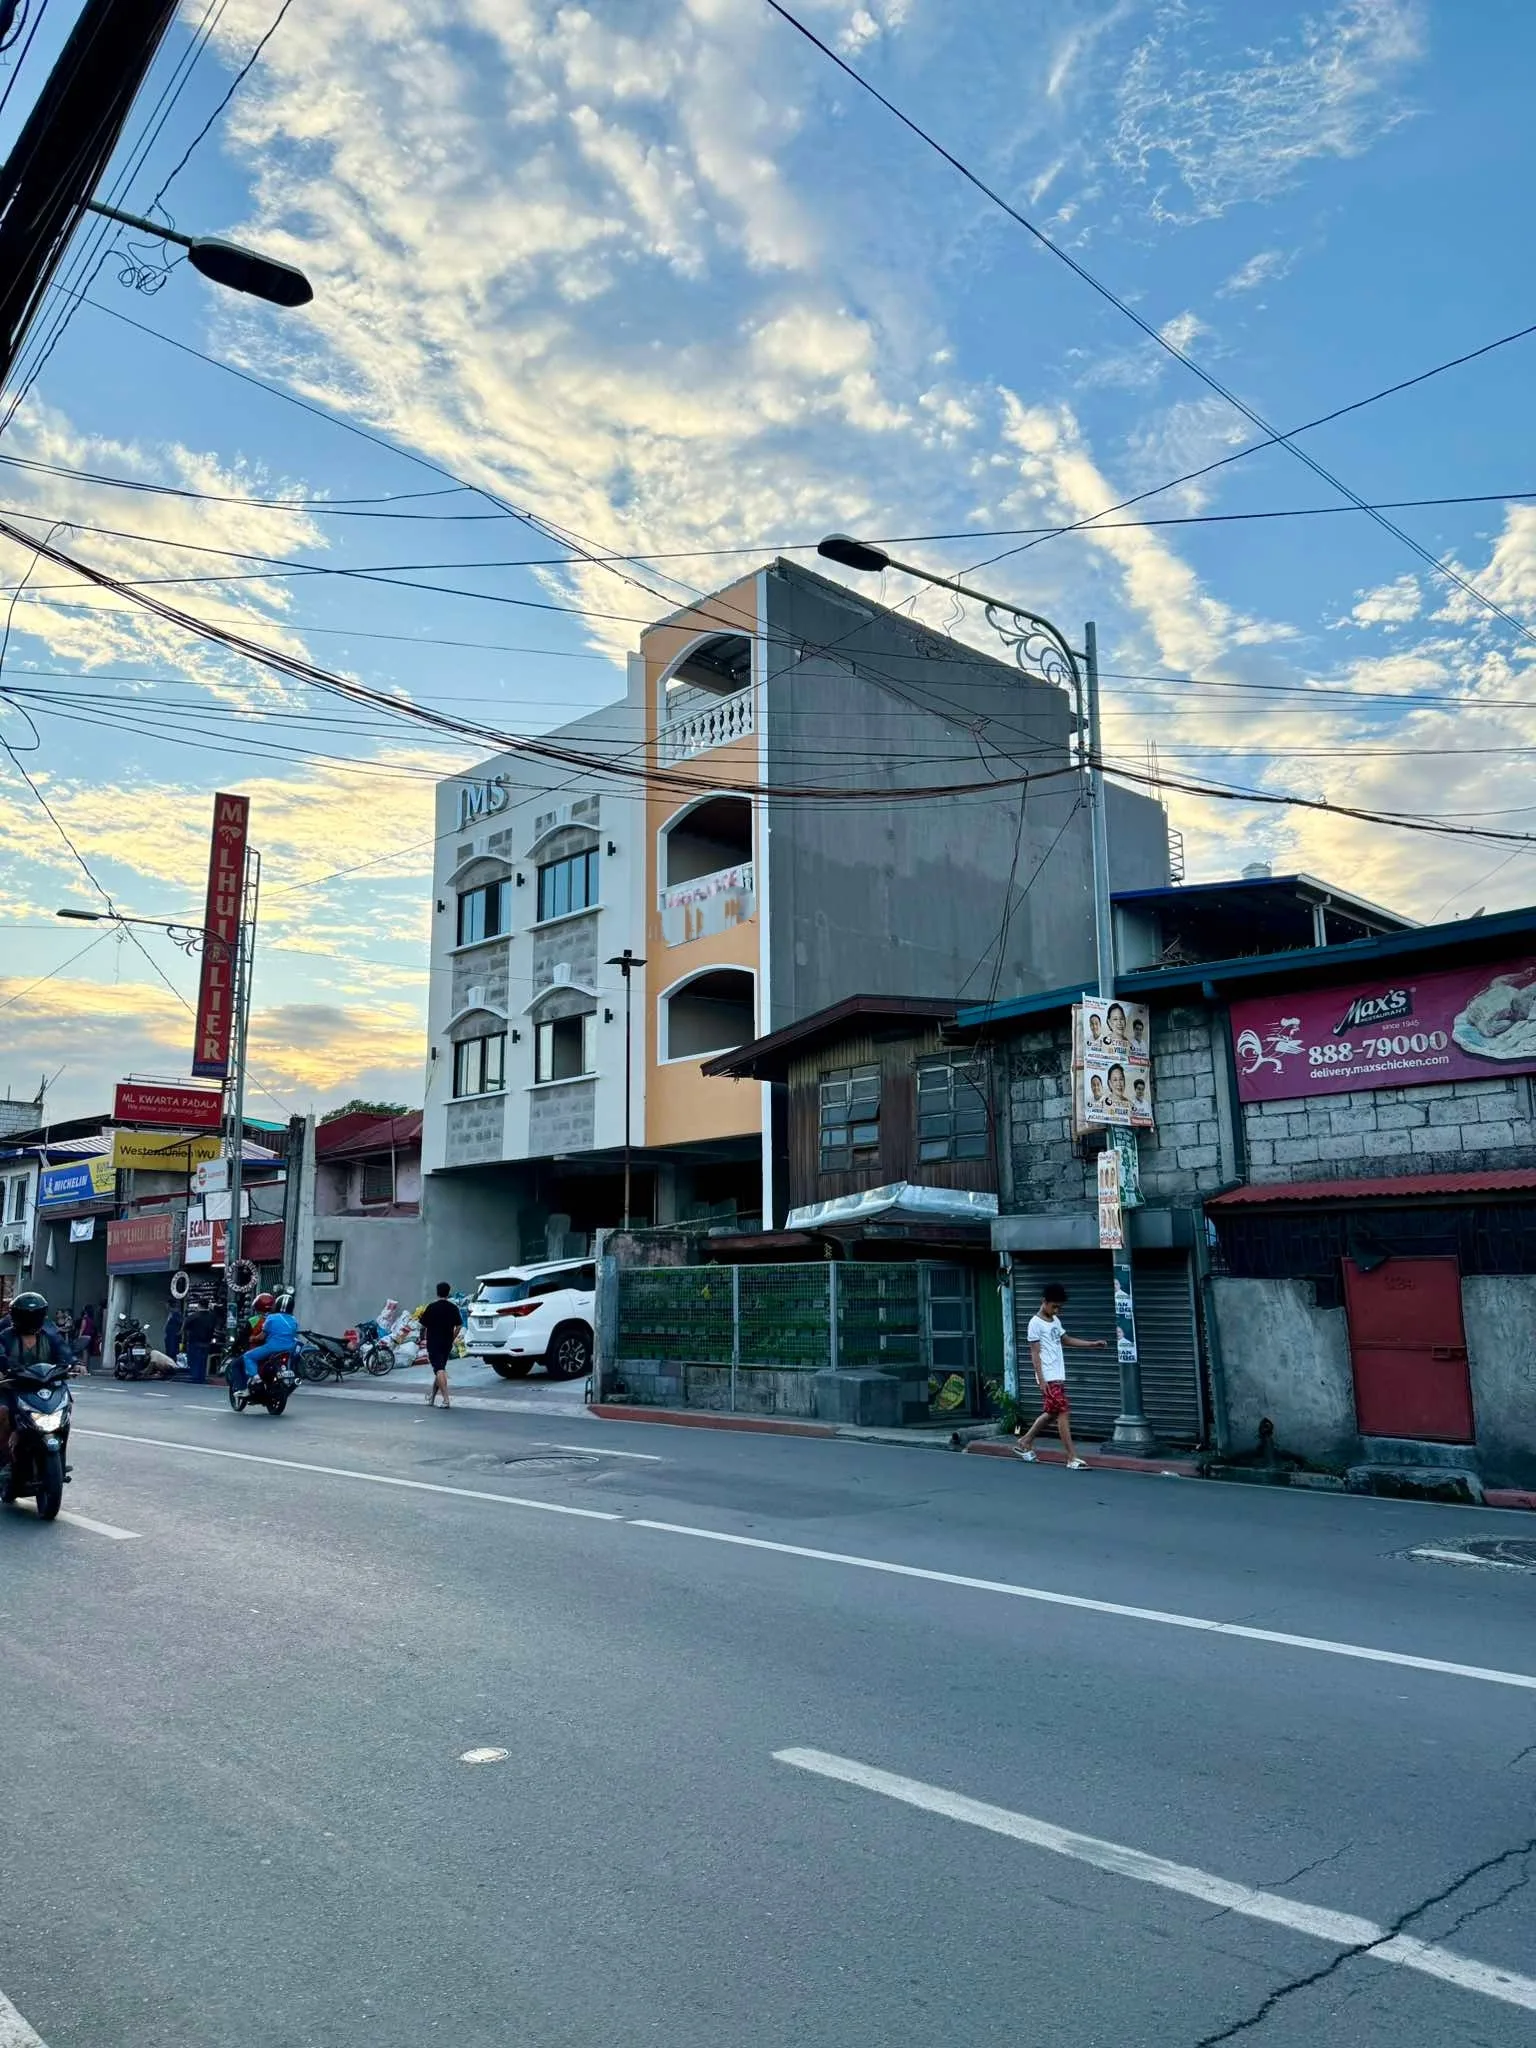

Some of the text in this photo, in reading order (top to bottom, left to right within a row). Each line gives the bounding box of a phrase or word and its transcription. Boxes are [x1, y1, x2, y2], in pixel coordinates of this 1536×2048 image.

[221, 801, 242, 823] M
[1332, 989, 1406, 1034] Max's
[1360, 1007, 1408, 1023] RESTAURANT
[1382, 1019, 1420, 1031] since 1945
[1308, 1030, 1448, 1065] 888-79000
[1310, 1055, 1450, 1079] delivery.maxschicken.com
[138, 1094, 180, 1107] KWARTA
[181, 1097, 218, 1109] PADALA
[197, 1149, 216, 1160] WU
[54, 1175, 88, 1192] MICHELIN
